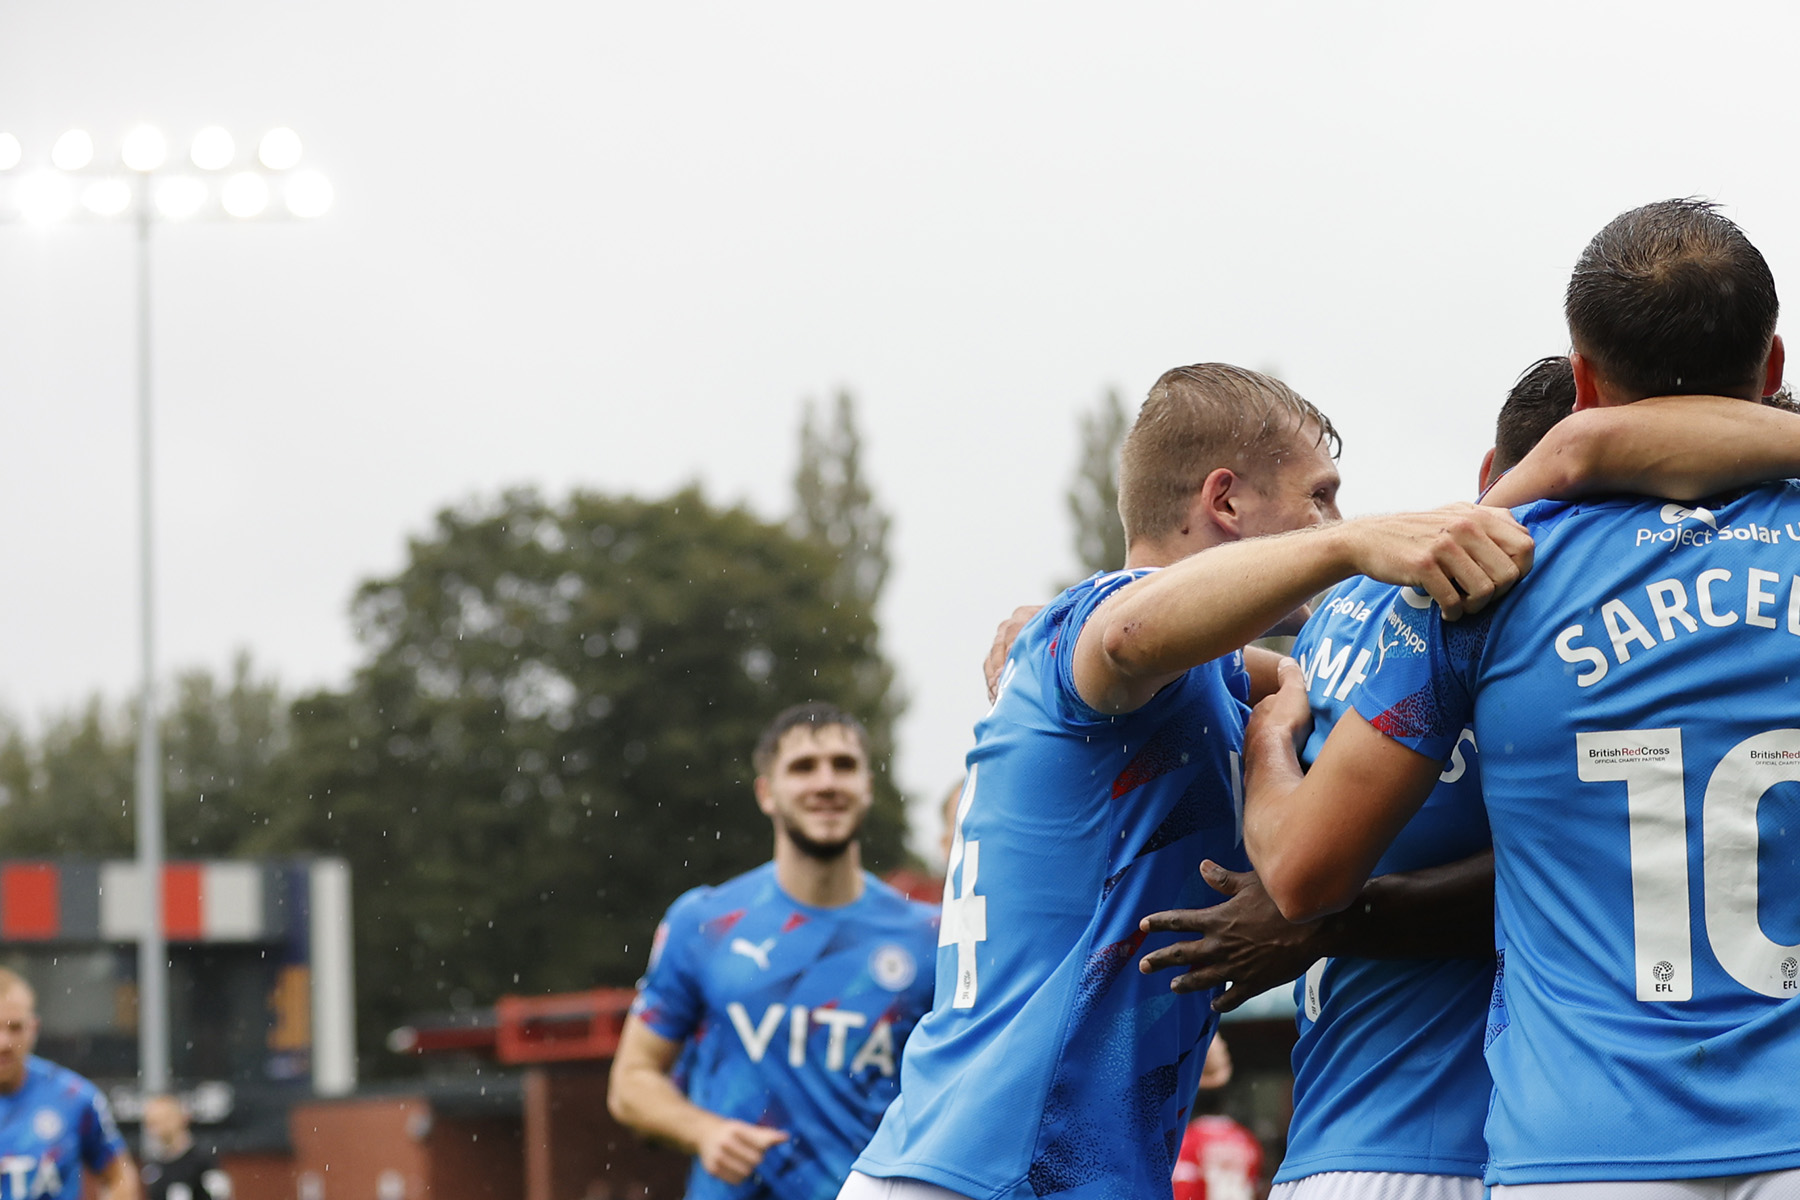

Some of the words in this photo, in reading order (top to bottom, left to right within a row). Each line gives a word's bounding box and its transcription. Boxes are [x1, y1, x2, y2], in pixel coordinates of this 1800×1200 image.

[1635, 523, 1712, 552] Project
[1718, 524, 1781, 544] Solar
[1655, 983, 1674, 993] EFL
[1783, 980, 1798, 990] EFL
[727, 1002, 897, 1078] VITA
